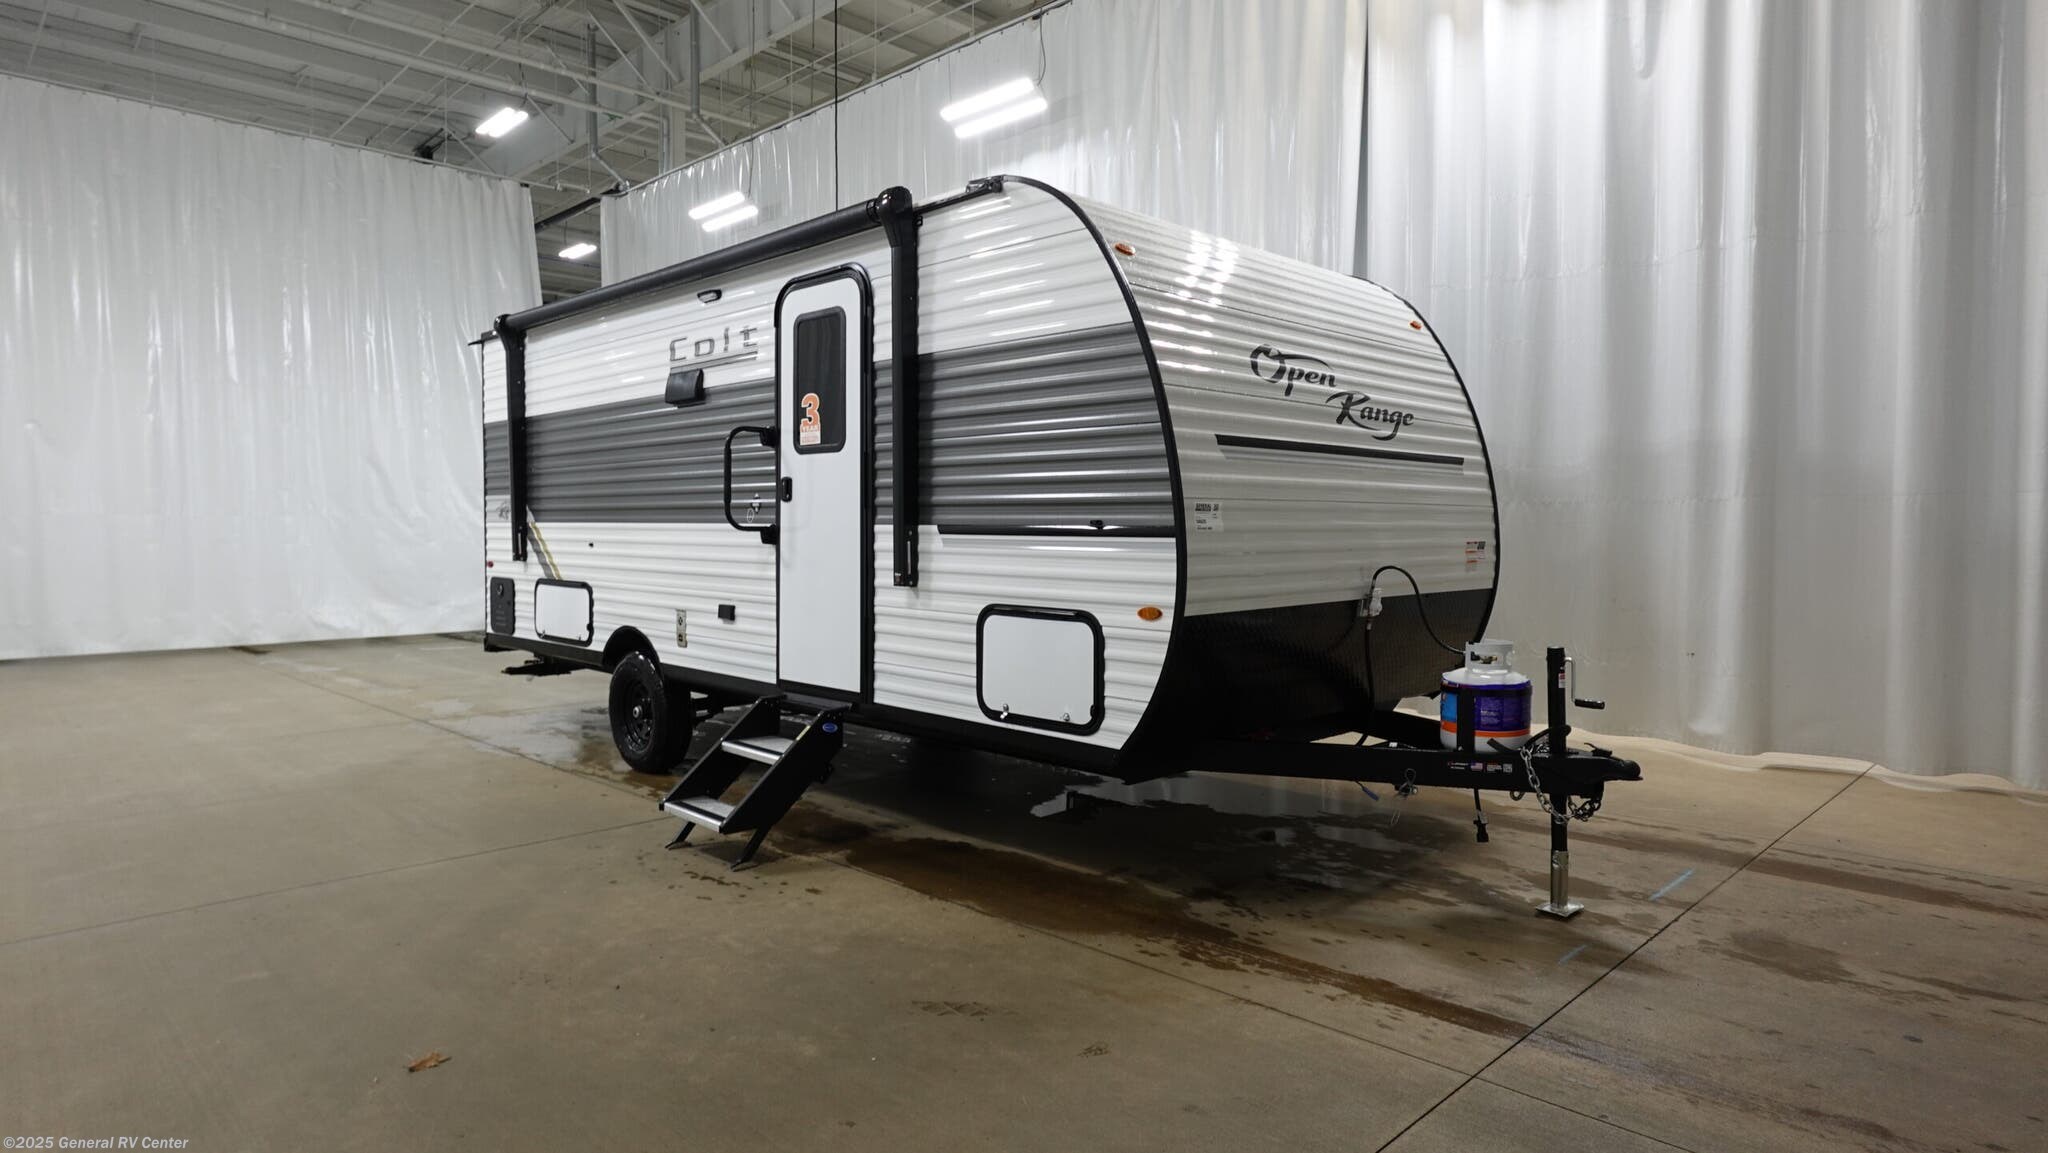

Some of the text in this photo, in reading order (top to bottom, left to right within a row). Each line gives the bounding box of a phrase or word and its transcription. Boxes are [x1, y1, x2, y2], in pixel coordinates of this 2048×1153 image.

[669, 325, 758, 362] Colt
[1249, 344, 1337, 397] Open
[801, 392, 820, 427] 3
[1325, 390, 1415, 441] Range
